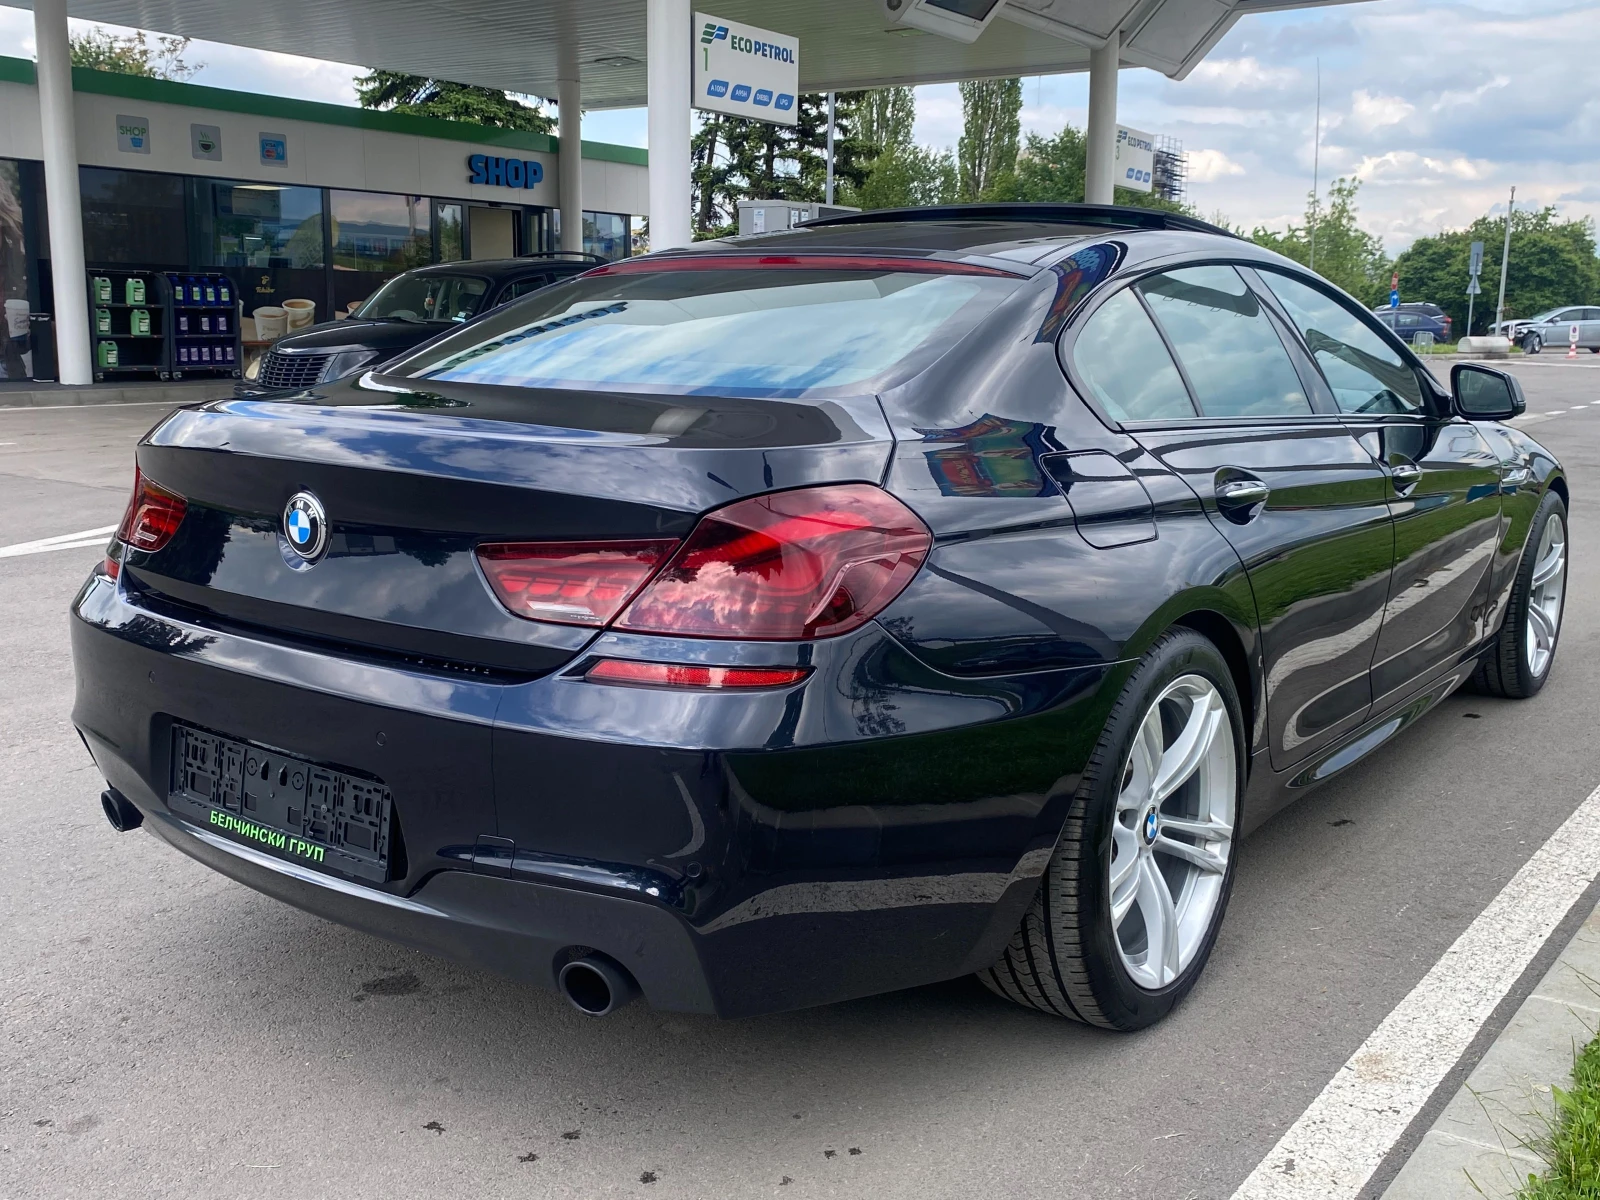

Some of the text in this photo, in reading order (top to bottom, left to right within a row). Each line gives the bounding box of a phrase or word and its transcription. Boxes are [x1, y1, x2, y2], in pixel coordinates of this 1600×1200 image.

[703, 47, 708, 71] 1
[731, 35, 794, 64] ECOPETROL
[756, 93, 770, 103] DIESEL
[119, 125, 147, 136] SHOP
[1127, 136, 1152, 152] ECOPETROL
[468, 154, 544, 189] SHOP
[209, 809, 325, 862] БЕЛЧИНСКИ ГРУП
